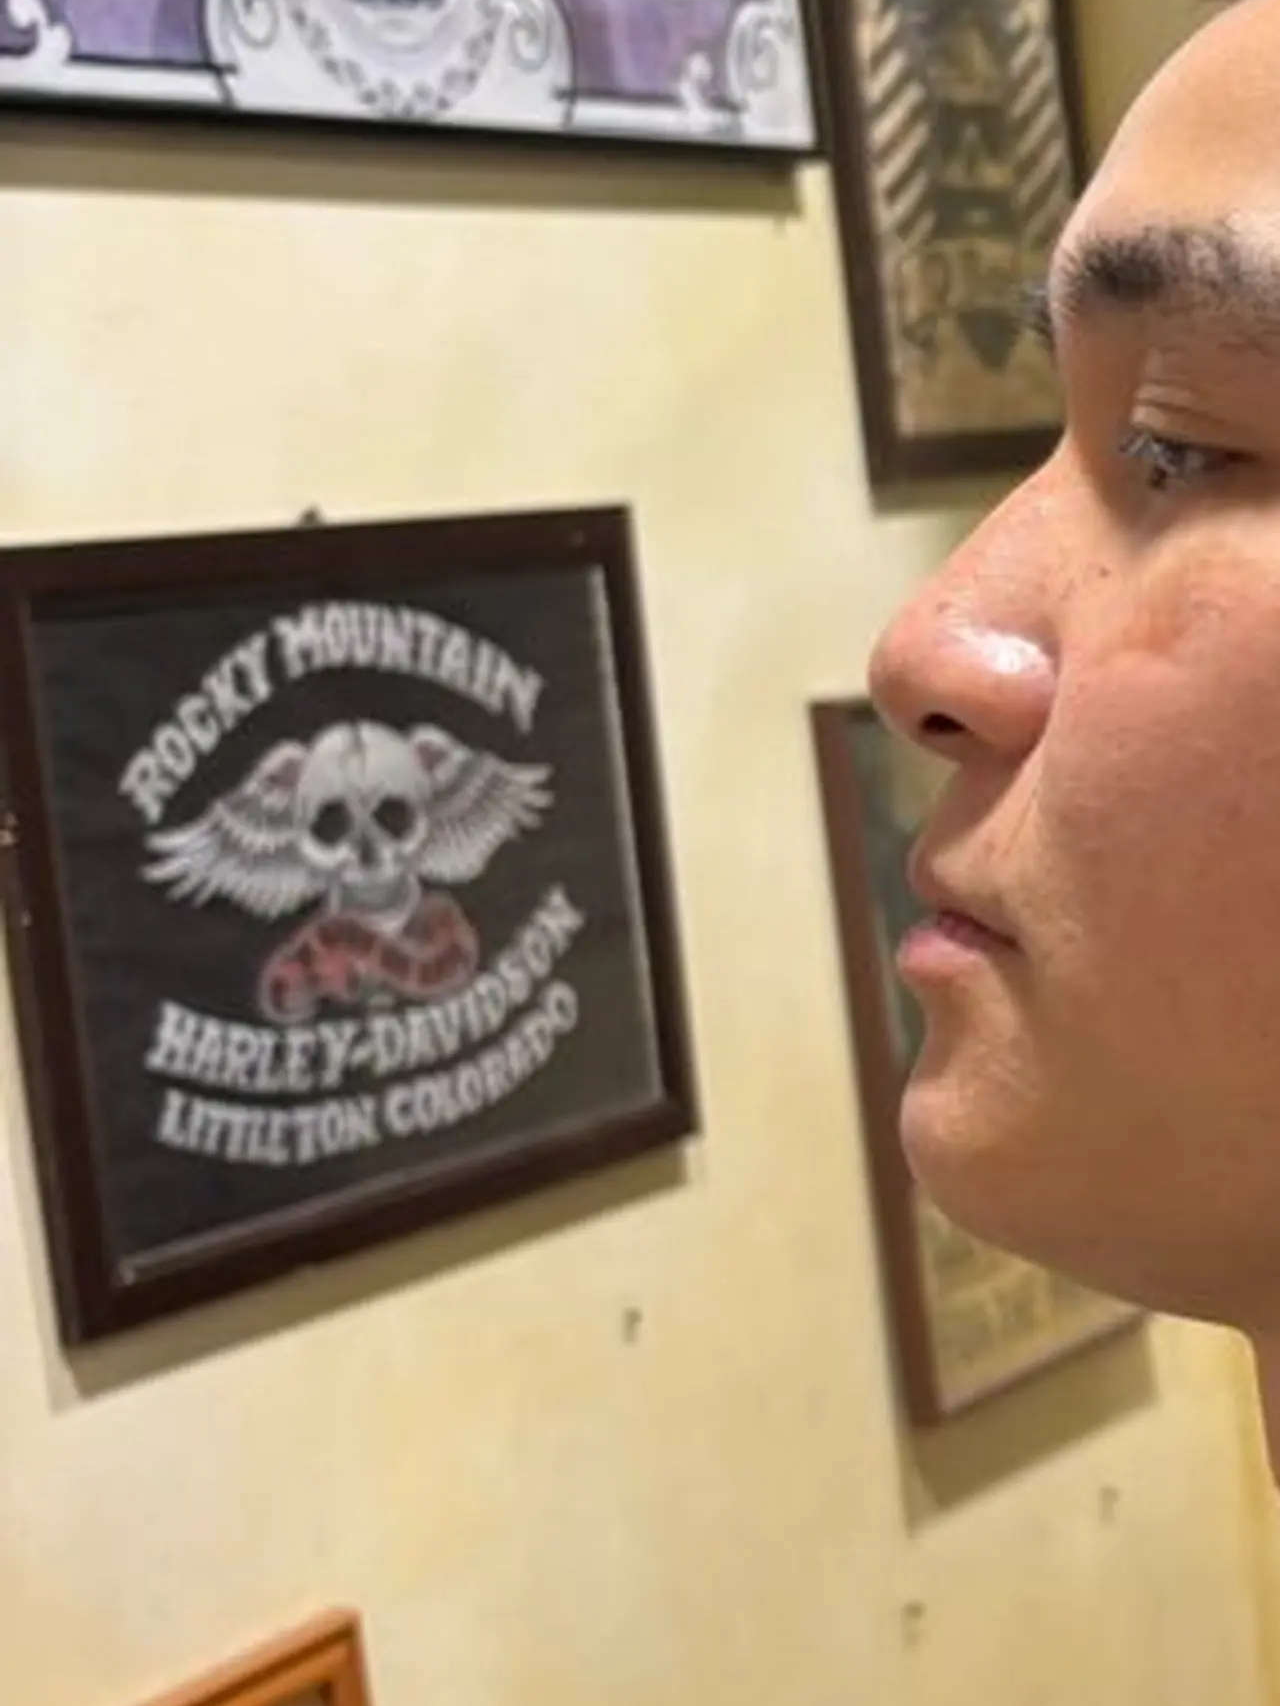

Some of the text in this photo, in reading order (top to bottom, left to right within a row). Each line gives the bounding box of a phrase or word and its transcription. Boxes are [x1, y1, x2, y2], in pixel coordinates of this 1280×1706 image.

[118, 600, 545, 825] ROCKY MOUNTAIN
[144, 883, 587, 1091] HARLEY-DAVIDSON
[156, 980, 579, 1166] LITTLETON COLORADO
